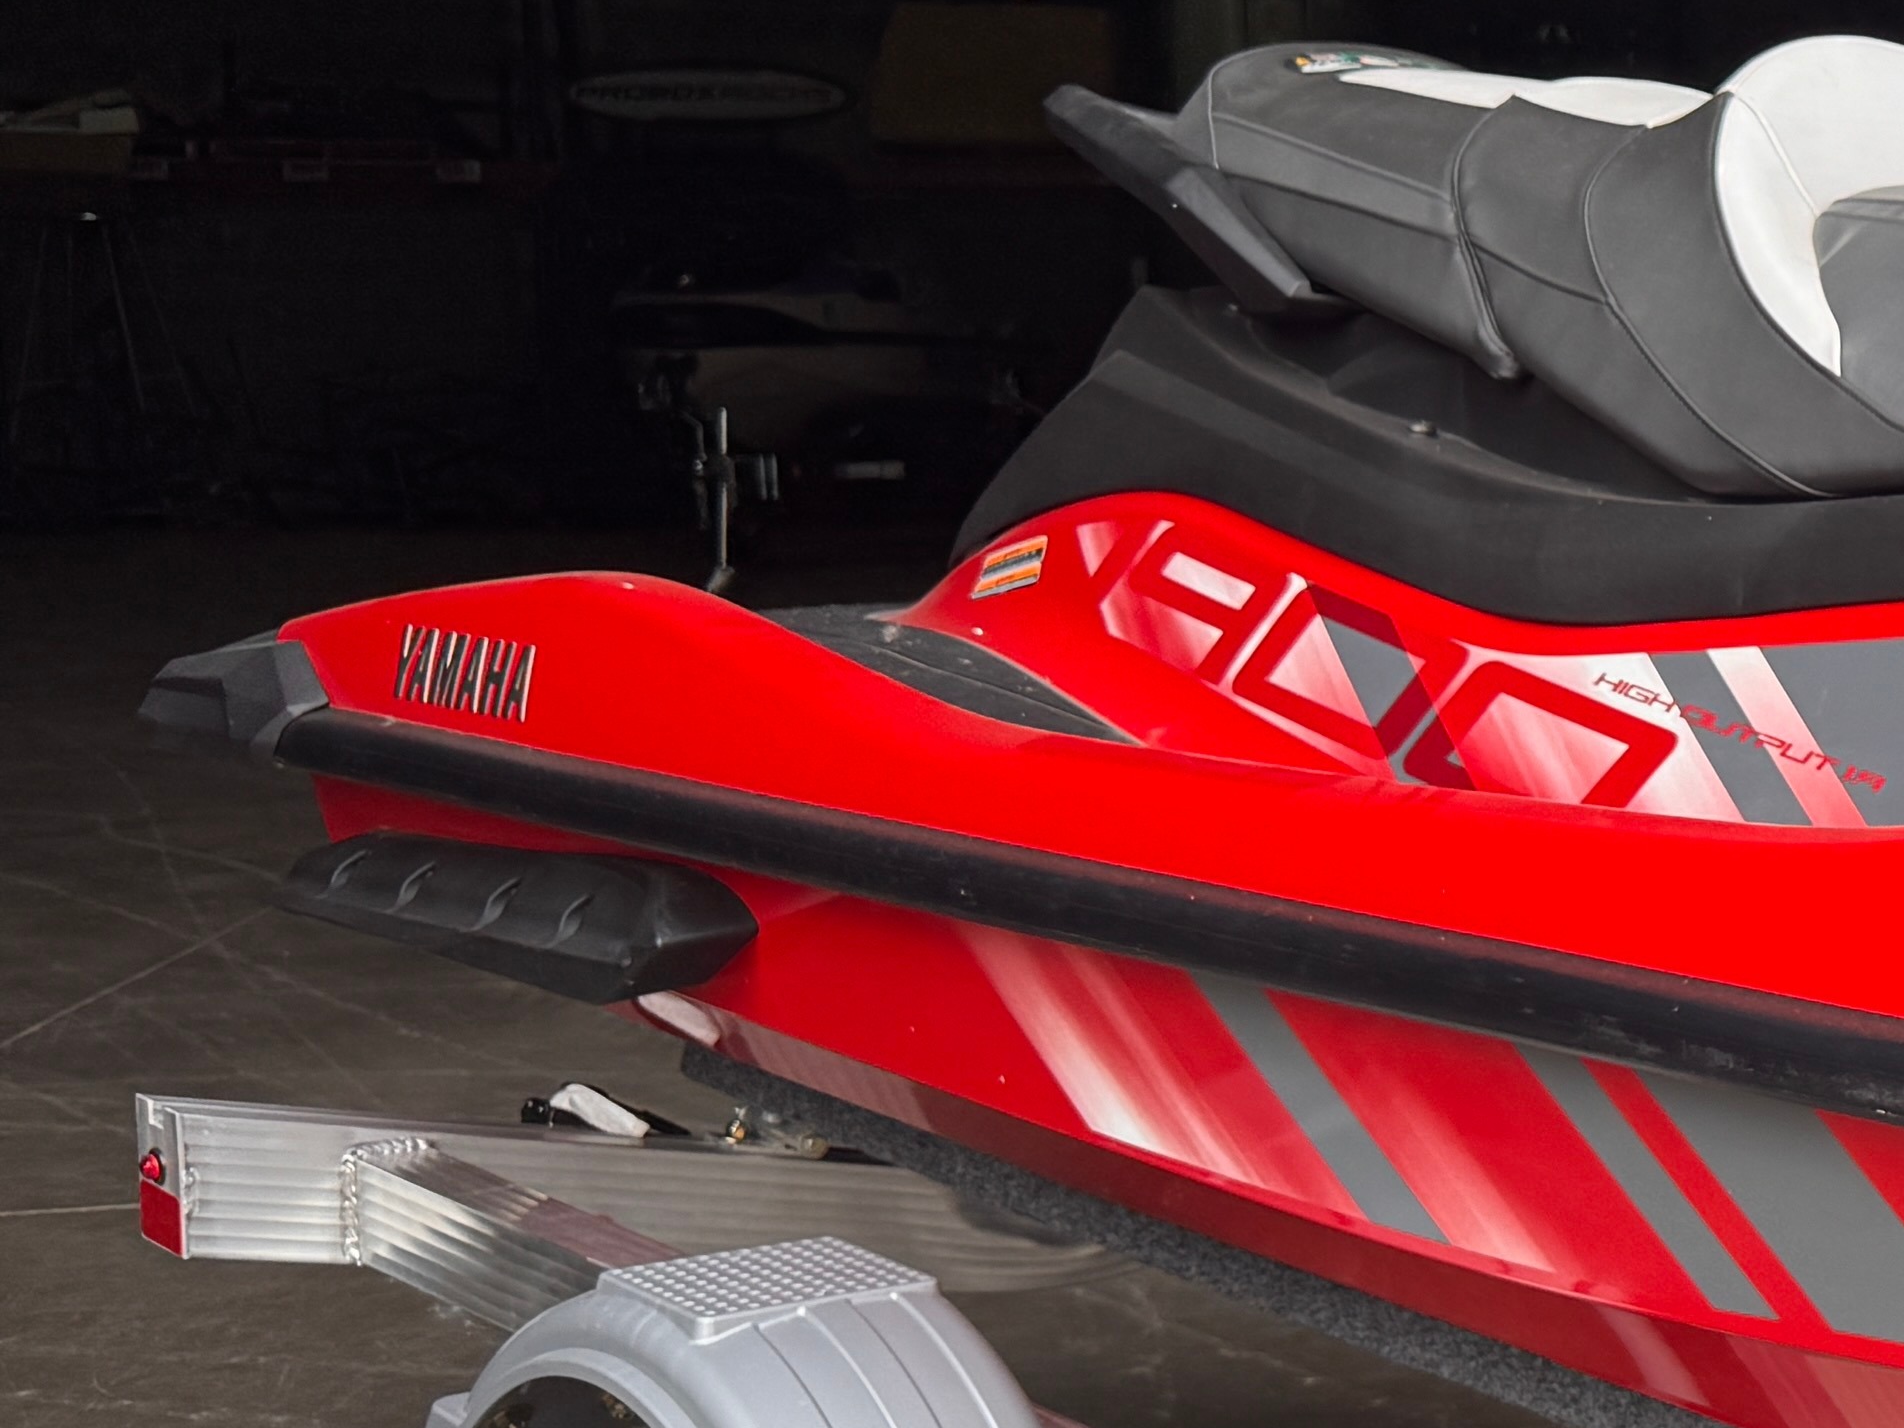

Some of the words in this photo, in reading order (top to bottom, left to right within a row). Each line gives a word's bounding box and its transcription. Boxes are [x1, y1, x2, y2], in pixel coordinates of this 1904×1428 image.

[395, 624, 536, 723] YAMAHA
[1593, 672, 1677, 712] HIGH
[1680, 704, 1841, 770] OUTPUT
